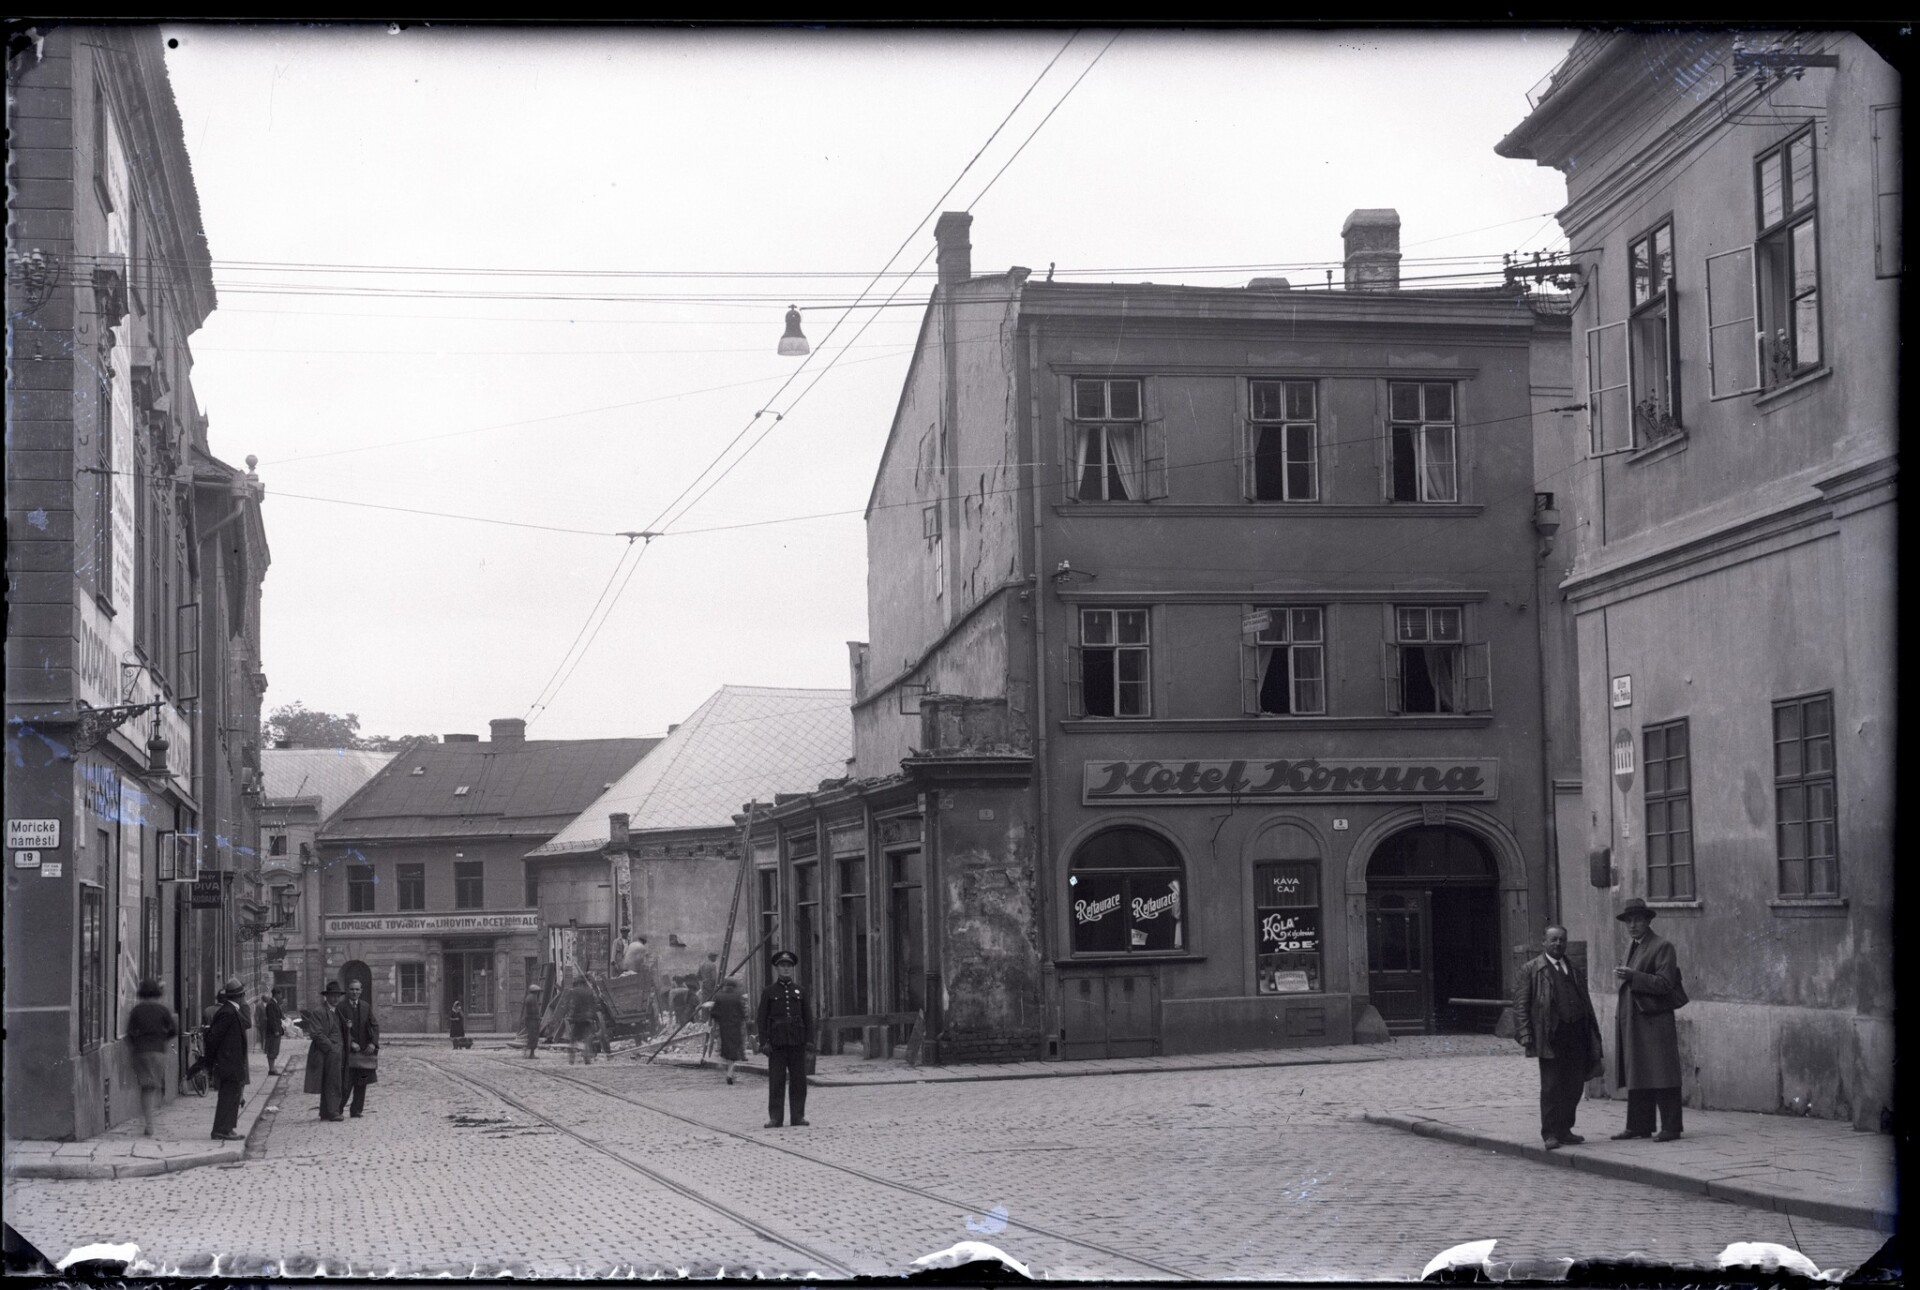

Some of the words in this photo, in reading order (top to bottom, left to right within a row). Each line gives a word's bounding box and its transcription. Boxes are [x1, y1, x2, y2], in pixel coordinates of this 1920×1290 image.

[1088, 760, 1250, 794] Hotel
[1250, 759, 1485, 793] Koruna
[11, 821, 56, 833] Mořické
[11, 835, 55, 846] náměstí
[23, 852, 33, 862] 19
[1075, 893, 1121, 921] Restaurace
[1131, 892, 1178, 919] Restaurace
